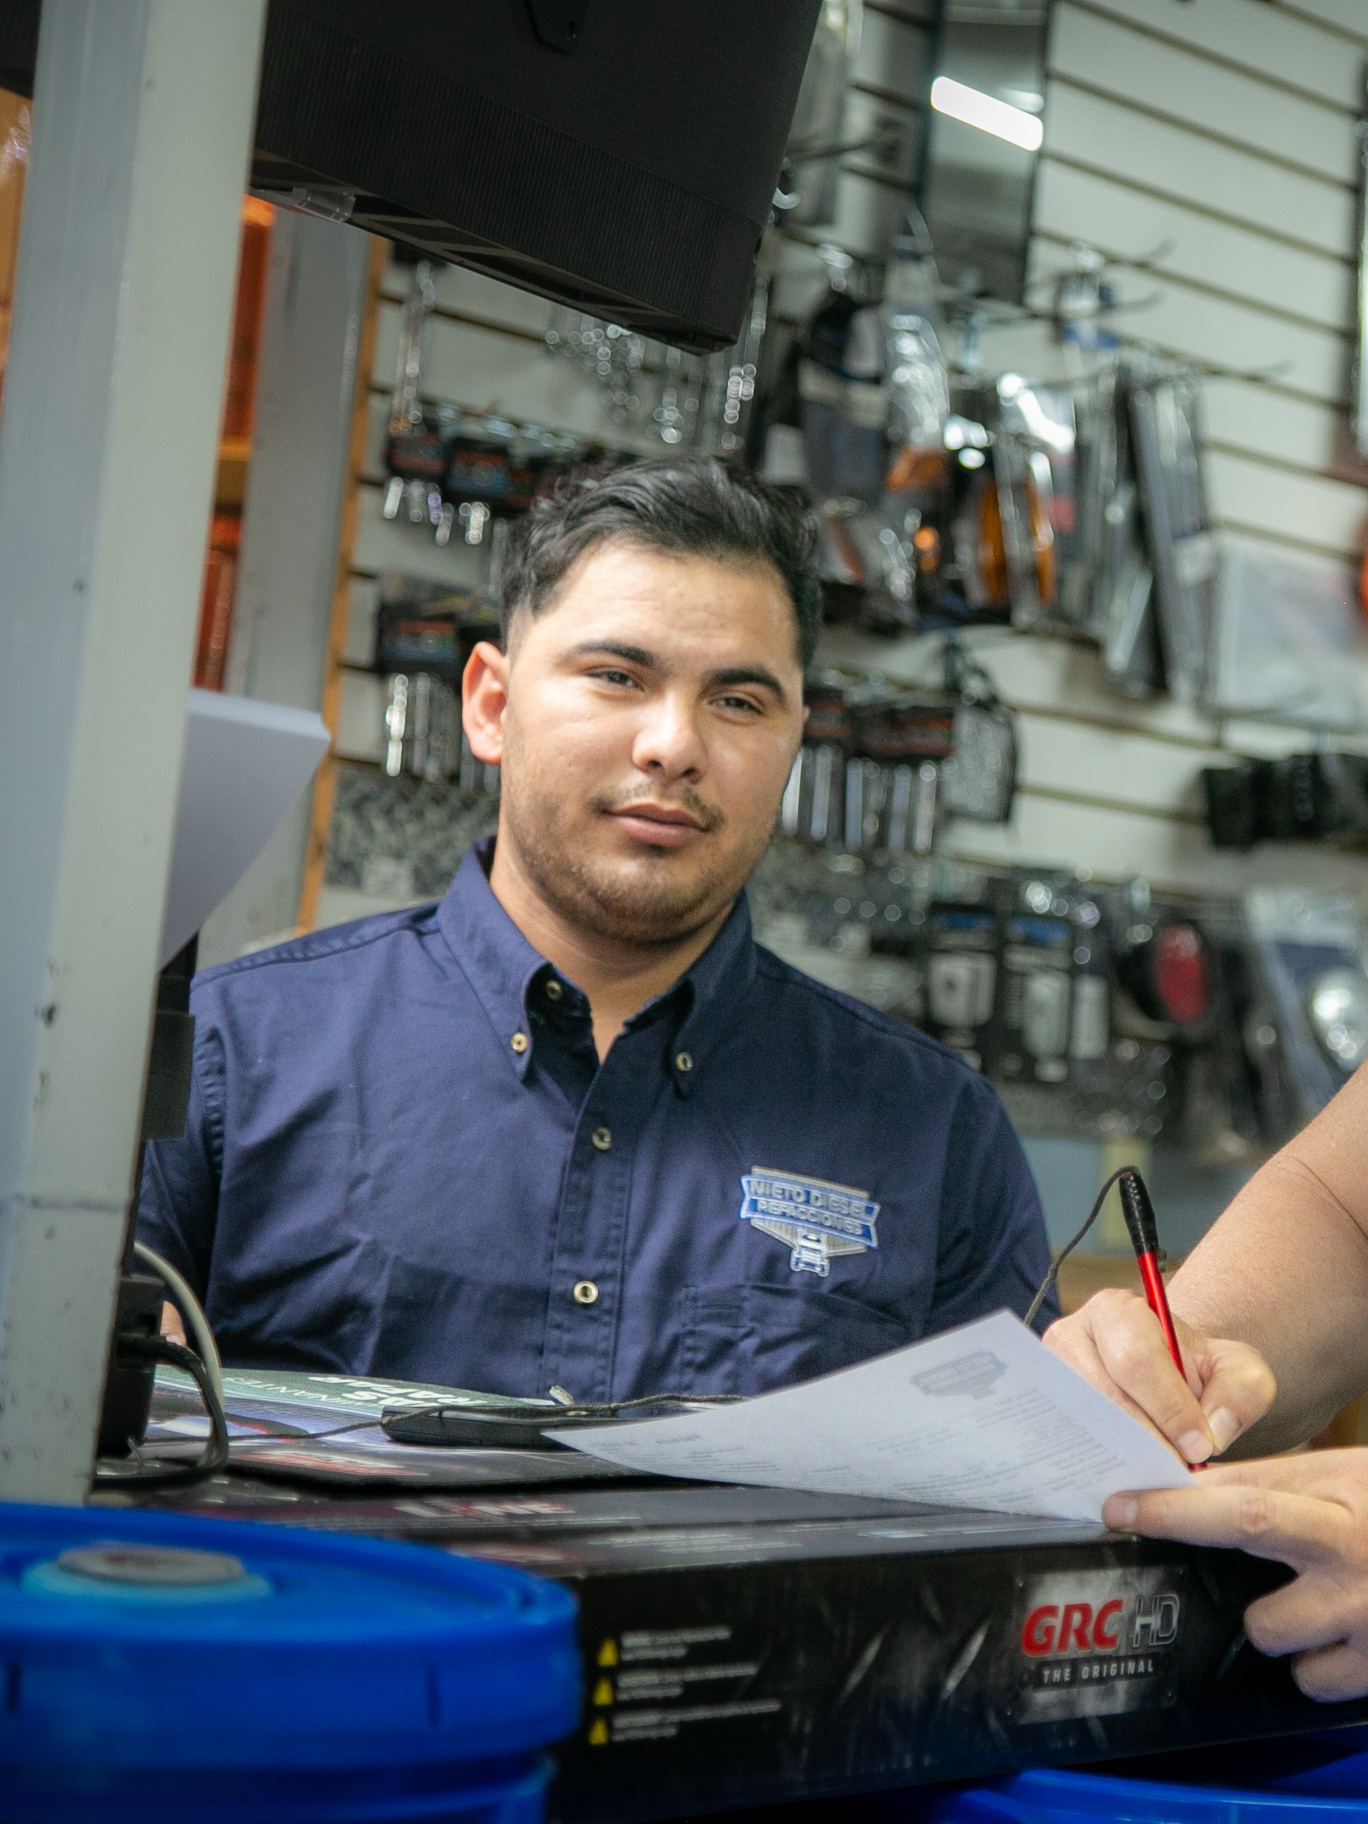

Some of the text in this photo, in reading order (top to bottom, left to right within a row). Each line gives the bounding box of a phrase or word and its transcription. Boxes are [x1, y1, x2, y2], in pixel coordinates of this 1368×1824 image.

[750, 1180, 866, 1215] NIETO DIESEL
[756, 1199, 863, 1236] REFACCIONES
[1020, 1593, 1181, 1658] GRC HD
[1043, 1659, 1154, 1684] THE ORIGINAL
